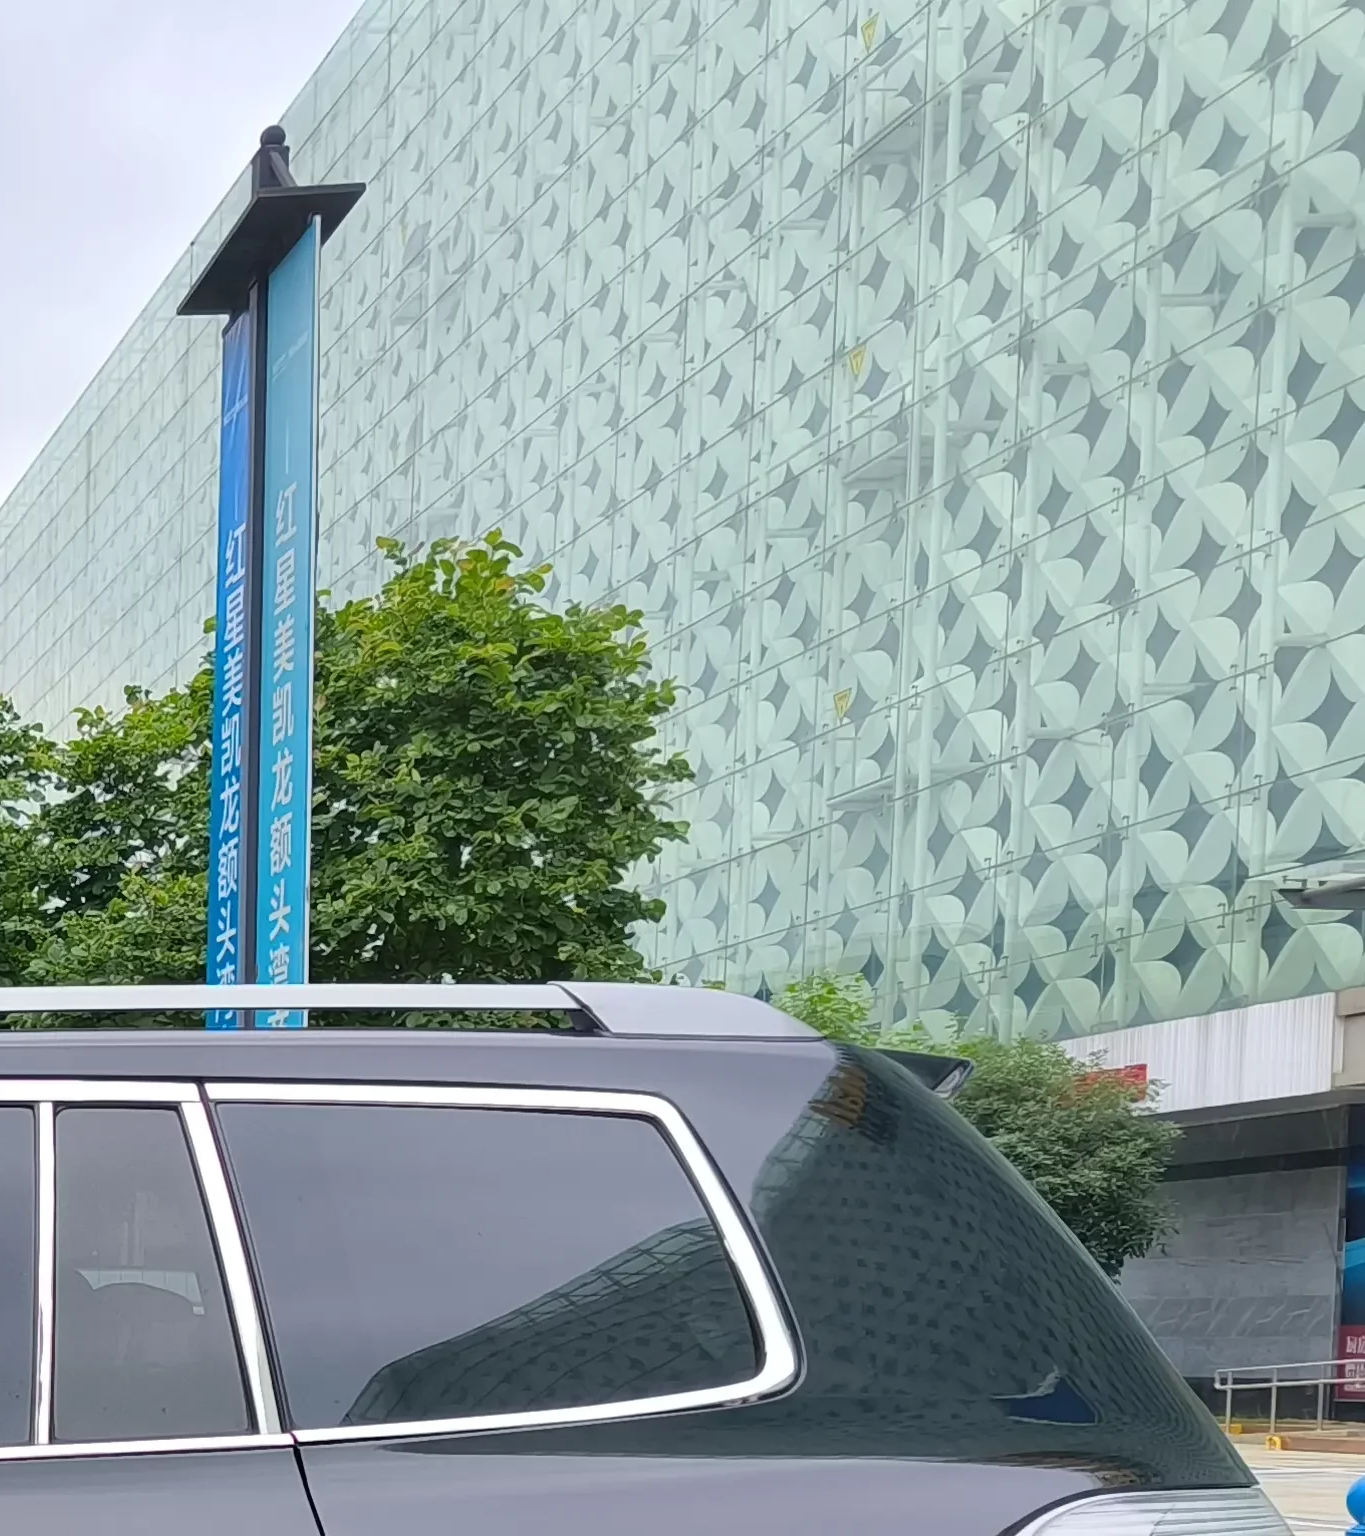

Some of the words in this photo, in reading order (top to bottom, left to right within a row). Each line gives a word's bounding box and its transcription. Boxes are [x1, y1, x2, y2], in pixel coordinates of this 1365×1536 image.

[216, 521, 247, 1028] 红星美凯龙额头湾
